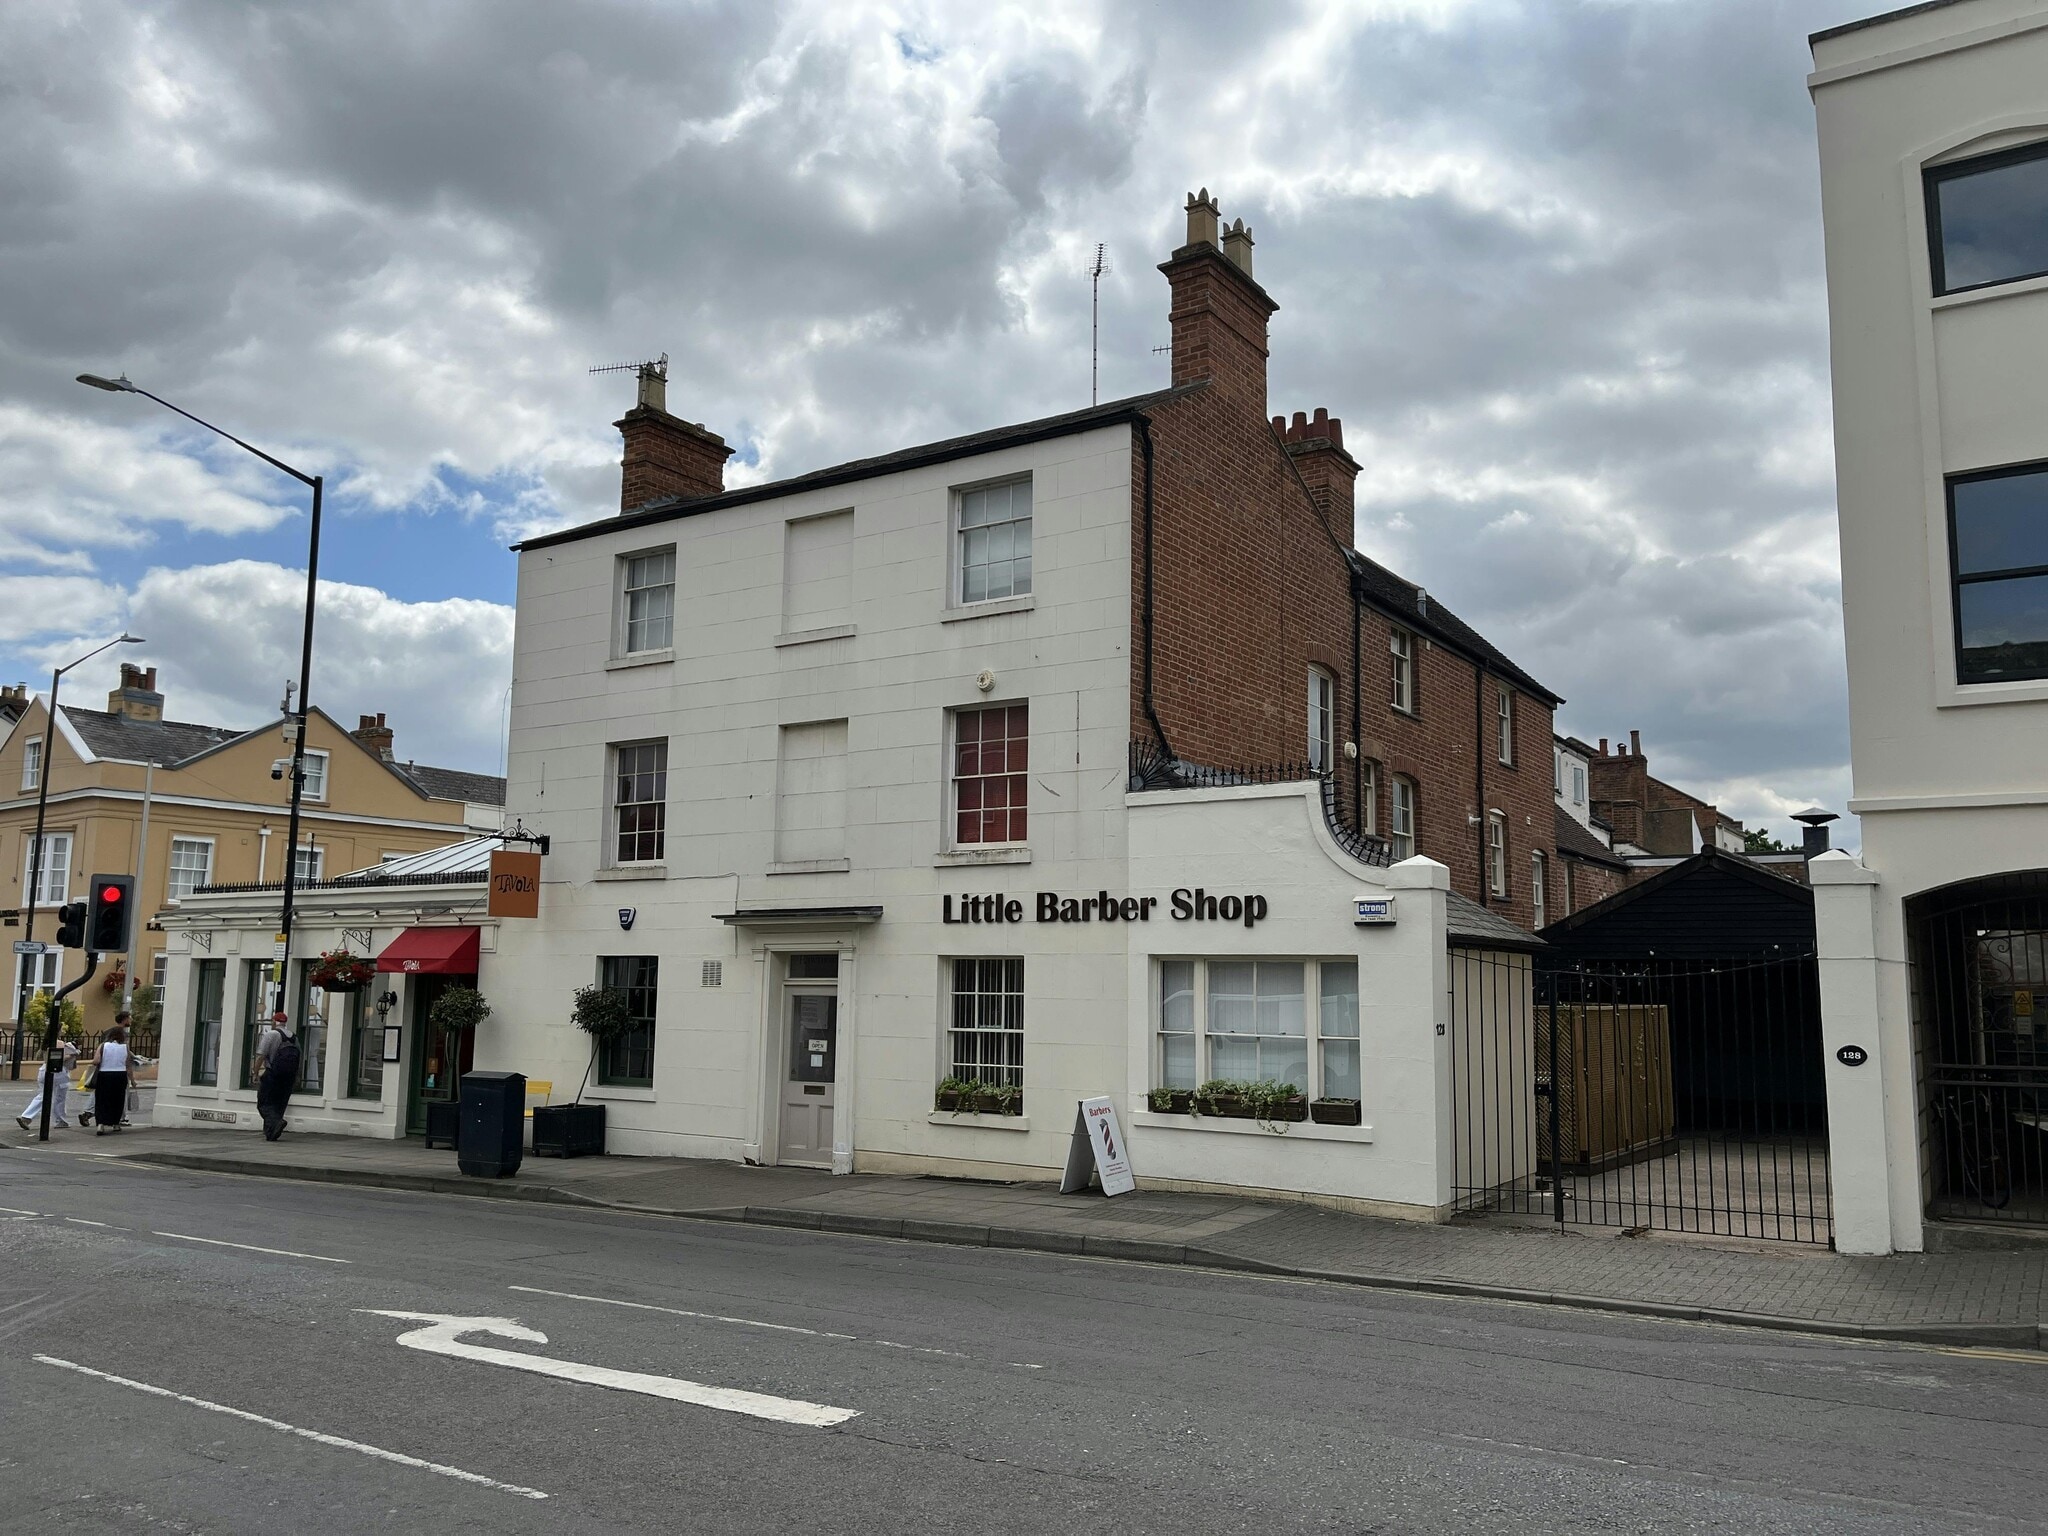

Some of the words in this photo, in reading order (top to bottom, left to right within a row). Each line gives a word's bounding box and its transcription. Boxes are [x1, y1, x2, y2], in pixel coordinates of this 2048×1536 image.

[494, 874, 535, 894] TAVOLA
[943, 893, 1022, 923] Little
[1036, 890, 1157, 923] Barber
[1170, 888, 1267, 927] Shop
[1359, 904, 1386, 914] strong
[1843, 1051, 1862, 1060] 128
[194, 1110, 215, 1120] WARWICK
[216, 1112, 235, 1122] STREET
[1089, 1106, 1111, 1117] Barbers
